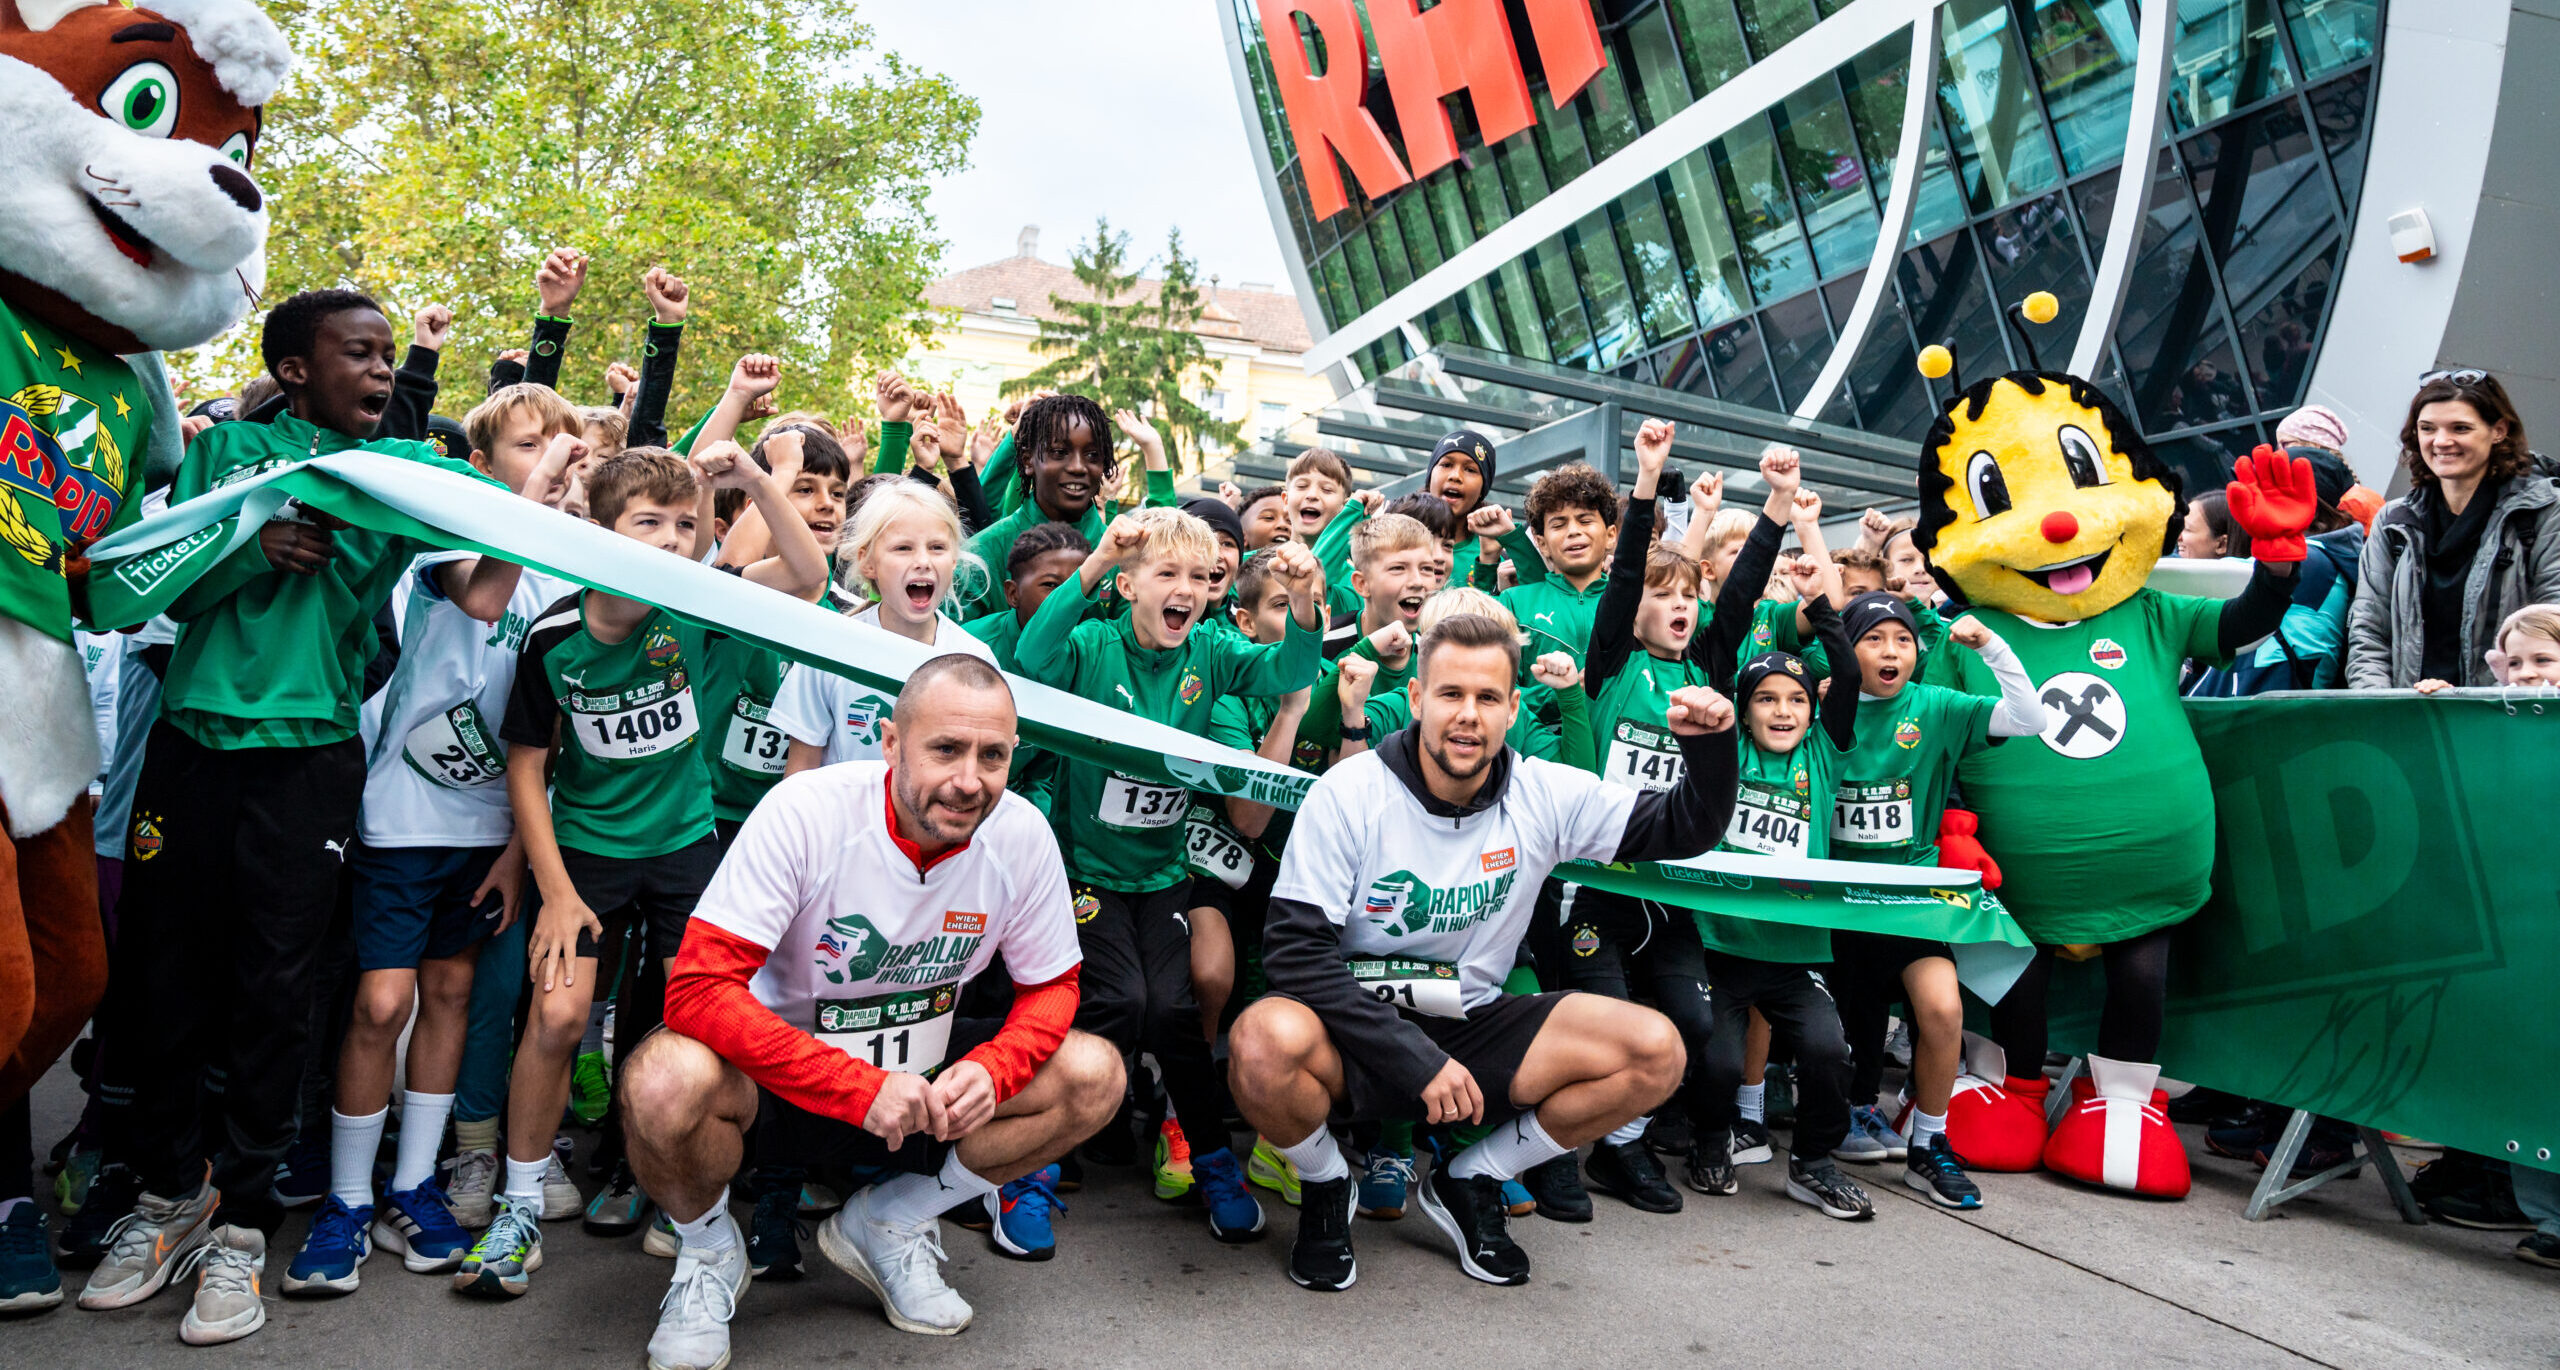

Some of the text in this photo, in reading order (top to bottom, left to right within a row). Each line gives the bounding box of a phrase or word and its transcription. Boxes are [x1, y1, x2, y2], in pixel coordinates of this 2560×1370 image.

[130, 530, 208, 584] Ticket:
[591, 700, 682, 745] 1408
[629, 744, 657, 755] Haris
[431, 745, 494, 785] 23
[1251, 780, 1306, 806] IN HÜT
[1141, 816, 1170, 826] Jasper
[1835, 804, 1901, 829] 1418
[1738, 809, 1800, 847] 1404
[1858, 832, 1878, 840] Nabil
[1186, 824, 1242, 871] 1378
[1757, 842, 1776, 852] Aras
[1191, 854, 1209, 866] Felix
[1485, 857, 1513, 869] ENERGIE
[1489, 852, 1508, 861] WIEN
[1664, 864, 1713, 882] Ticket:
[946, 922, 982, 931] ENERGIE
[955, 914, 979, 923] WIEN
[1432, 917, 1447, 933] IN
[1376, 984, 1417, 1007] 21
[845, 1008, 880, 1020] RAPIDLAUF
[888, 1003, 898, 1016] 12.
[900, 1002, 909, 1014] 10.
[912, 998, 930, 1012] 2025
[867, 1029, 909, 1068] 11
